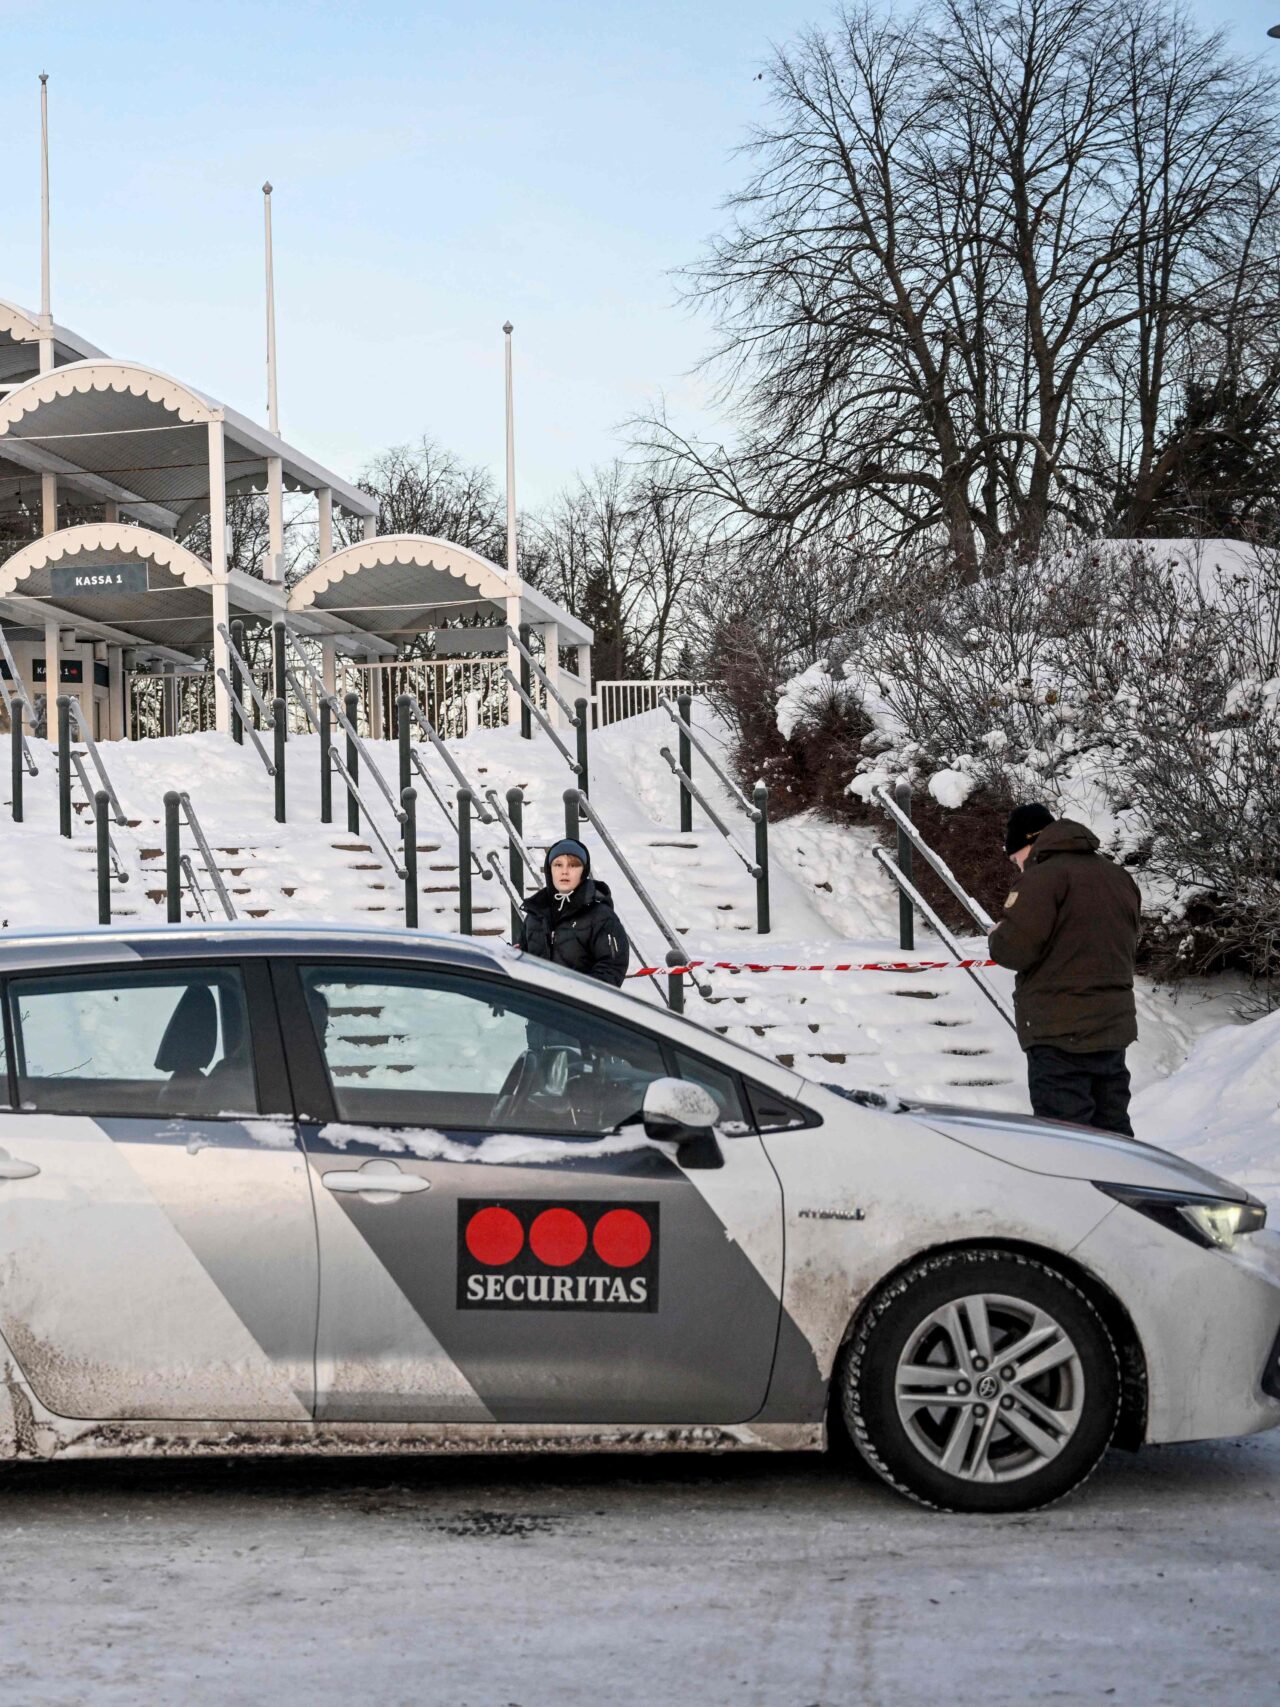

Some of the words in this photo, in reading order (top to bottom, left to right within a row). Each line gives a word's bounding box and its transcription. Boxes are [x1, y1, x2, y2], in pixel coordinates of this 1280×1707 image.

[75, 575, 112, 586] KASSA
[116, 573, 123, 584] 1
[467, 1274, 647, 1303] SECURITAS
